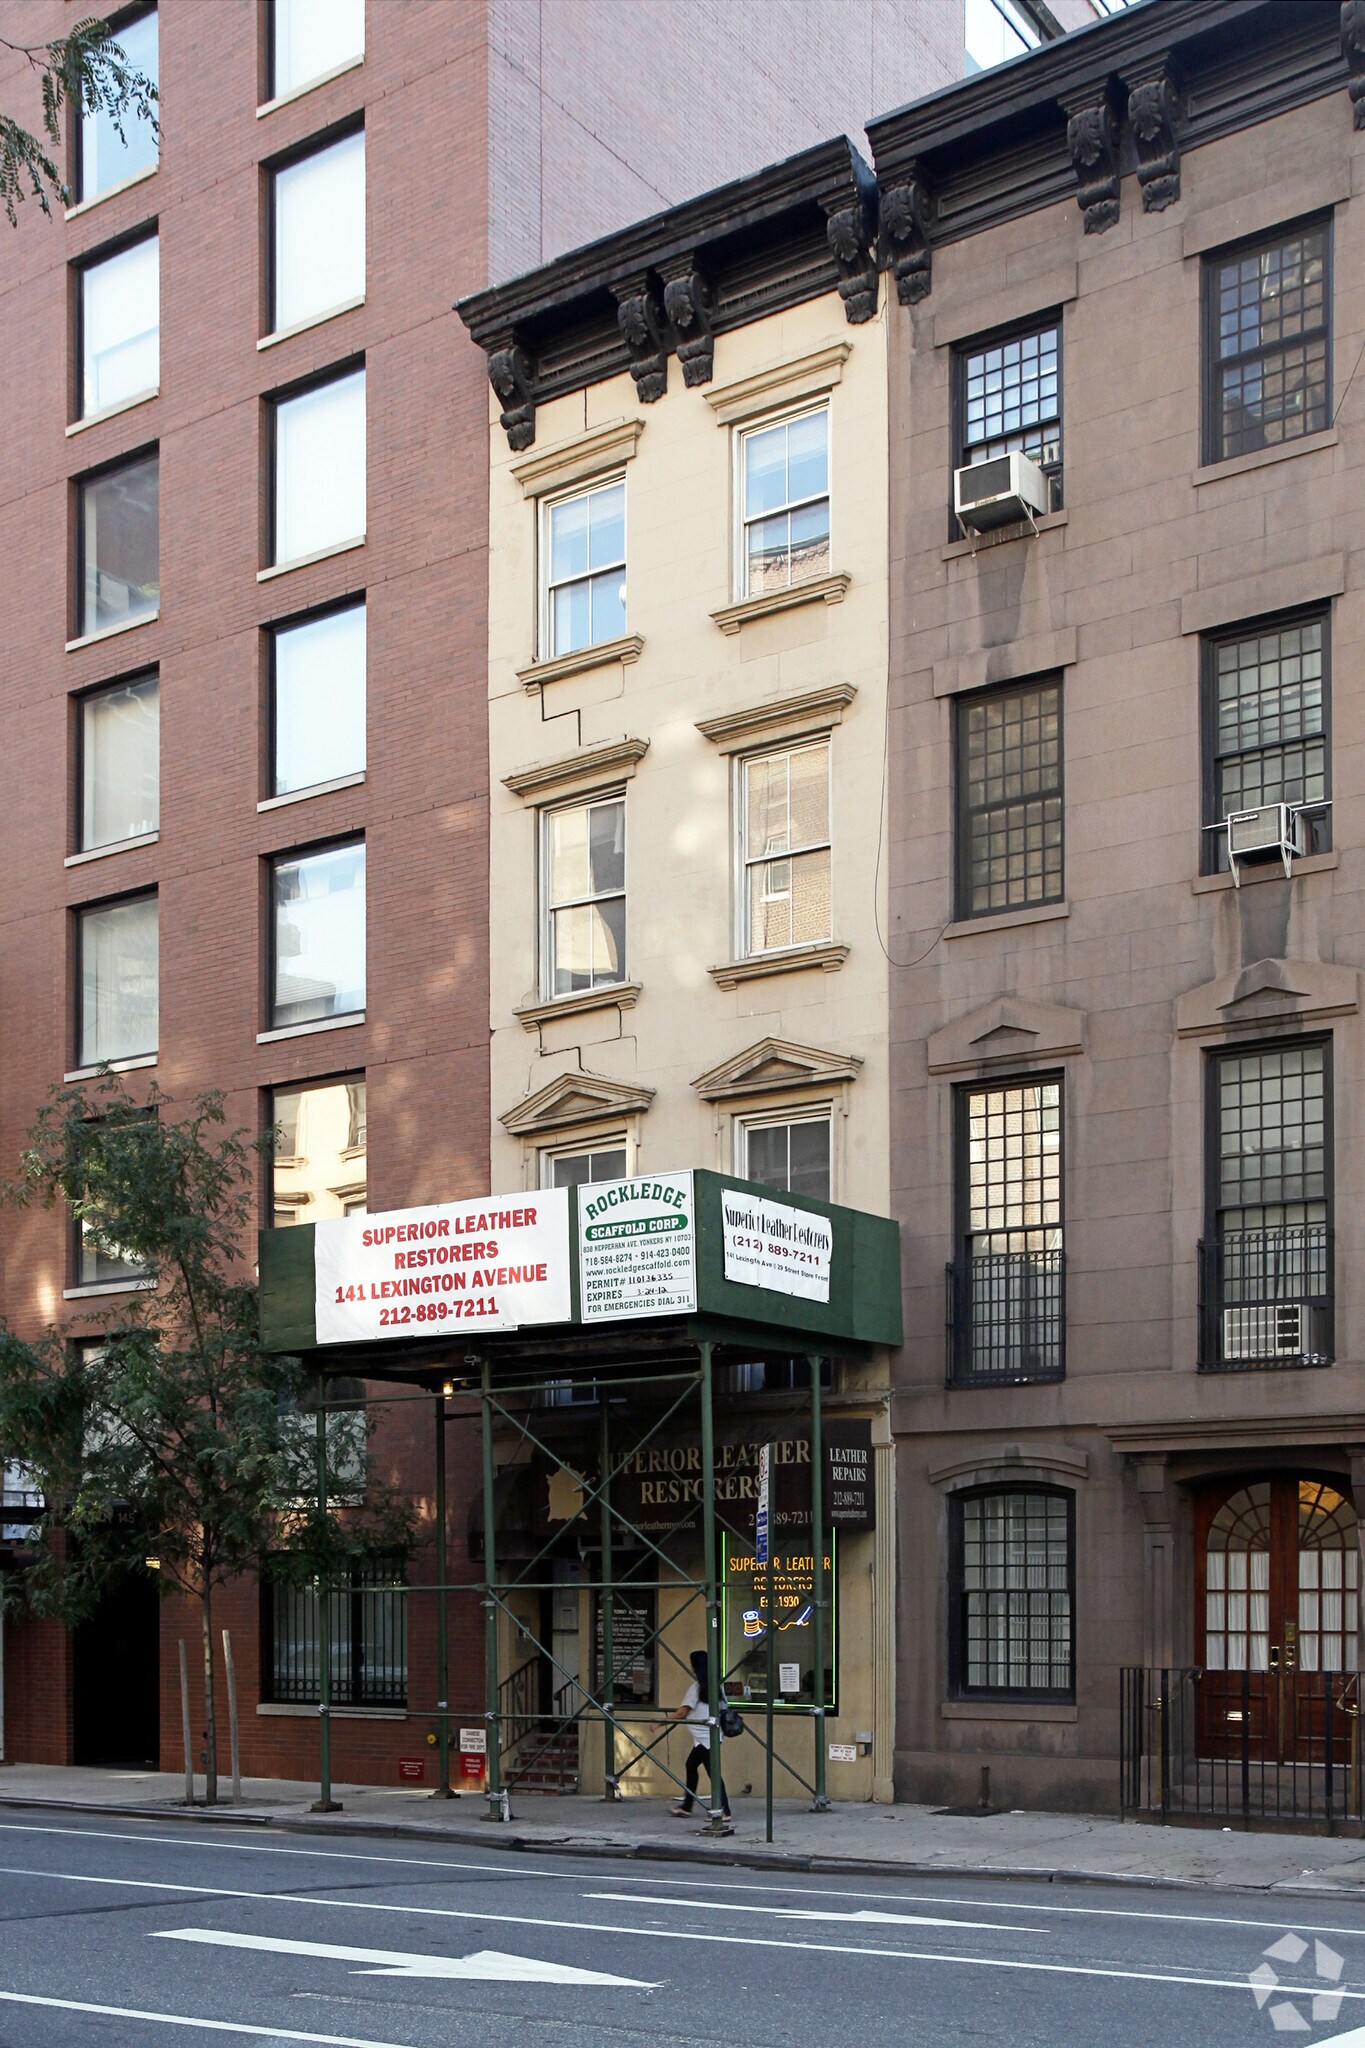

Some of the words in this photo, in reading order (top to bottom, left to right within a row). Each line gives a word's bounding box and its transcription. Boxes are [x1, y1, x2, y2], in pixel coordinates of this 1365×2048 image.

[585, 1183, 686, 1220] ROCKLEDGE
[362, 1219, 450, 1246] SUPERIOR
[455, 1207, 537, 1235] LEATHER
[591, 1222, 646, 1239] SCAFFOLD
[650, 1217, 682, 1231] CORP.
[762, 1213, 793, 1240] Leather
[794, 1223, 829, 1251] Restorers
[640, 1237, 663, 1246] YONKERS
[665, 1235, 672, 1243] NY
[394, 1241, 498, 1270] RESTORERS
[585, 1253, 632, 1266] 718-584-8274
[640, 1246, 690, 1260] 914-423-0400
[732, 1235, 763, 1253] (212)
[768, 1243, 819, 1266] 889-7211
[586, 1258, 690, 1277] www.rockledgescaffold.com
[761, 1260, 773, 1268] Ave
[784, 1266, 800, 1276] Street
[335, 1284, 366, 1303] 141
[371, 1272, 466, 1300] LEXINGTON
[471, 1263, 547, 1289] AVENUE
[586, 1278, 626, 1290] PERMIT#
[587, 1290, 622, 1302] EXPIRES
[588, 1304, 601, 1313] FOR
[604, 1298, 655, 1311] EMERGENCIES
[658, 1296, 675, 1306] DIAL
[677, 1295, 690, 1304] 311
[379, 1297, 499, 1326] 212-889-7211
[711, 1439, 812, 1469] EATER
[829, 1447, 867, 1464] LEATHER
[832, 1466, 866, 1482] REPAIRS
[748, 1511, 813, 1526] 289-7211
[729, 1557, 780, 1571] SUPERIR
[786, 1556, 831, 1571] LEATR
[753, 1576, 813, 1590] RETORERS
[778, 1595, 800, 1608] 1930
